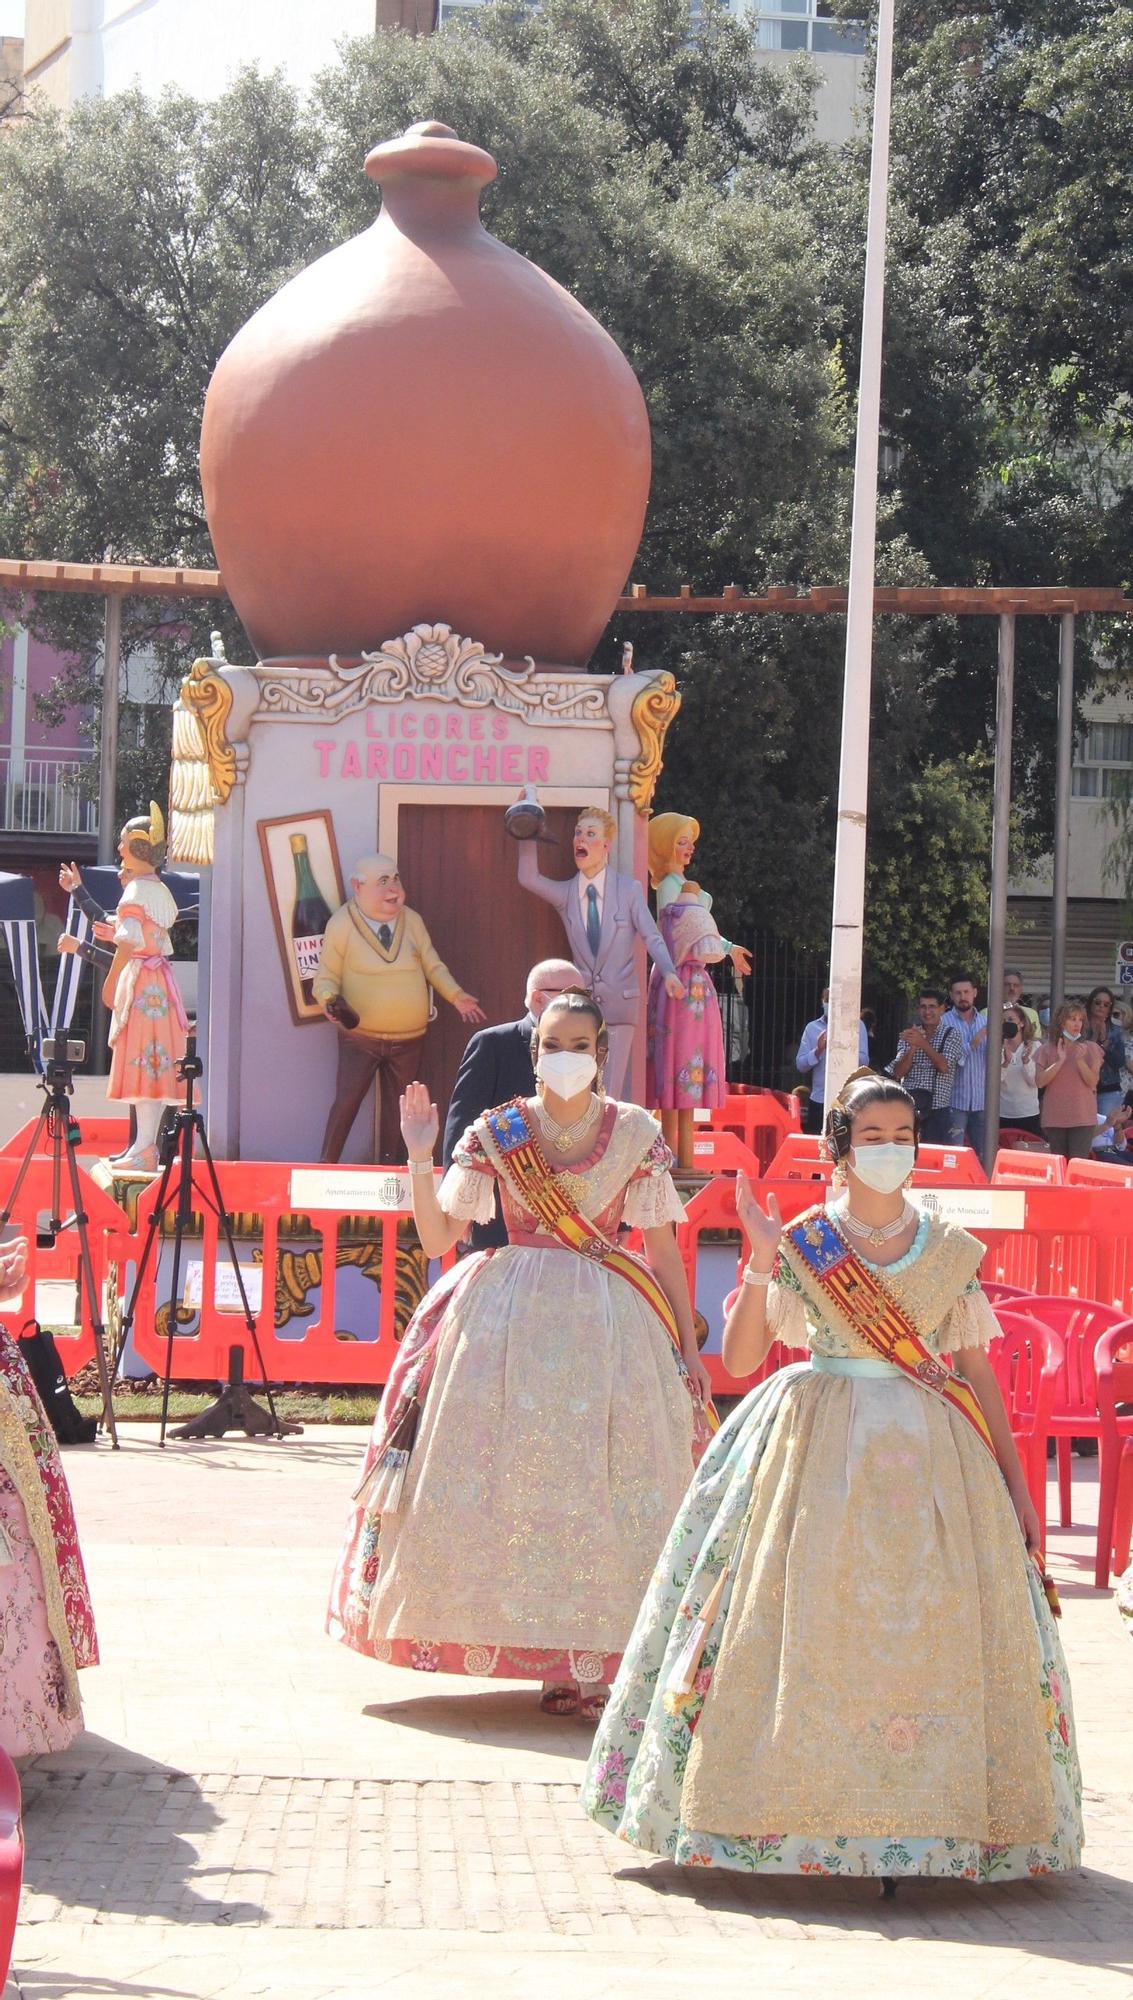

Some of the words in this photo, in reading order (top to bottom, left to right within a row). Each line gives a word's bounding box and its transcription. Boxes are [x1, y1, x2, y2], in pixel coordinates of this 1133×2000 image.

[366, 712, 509, 740] LICORES
[313, 740, 549, 782] TARONCHER
[298, 952, 321, 967] TIN
[325, 1187, 376, 1197] Ayuntamiento
[957, 1207, 990, 1216] Moncada
